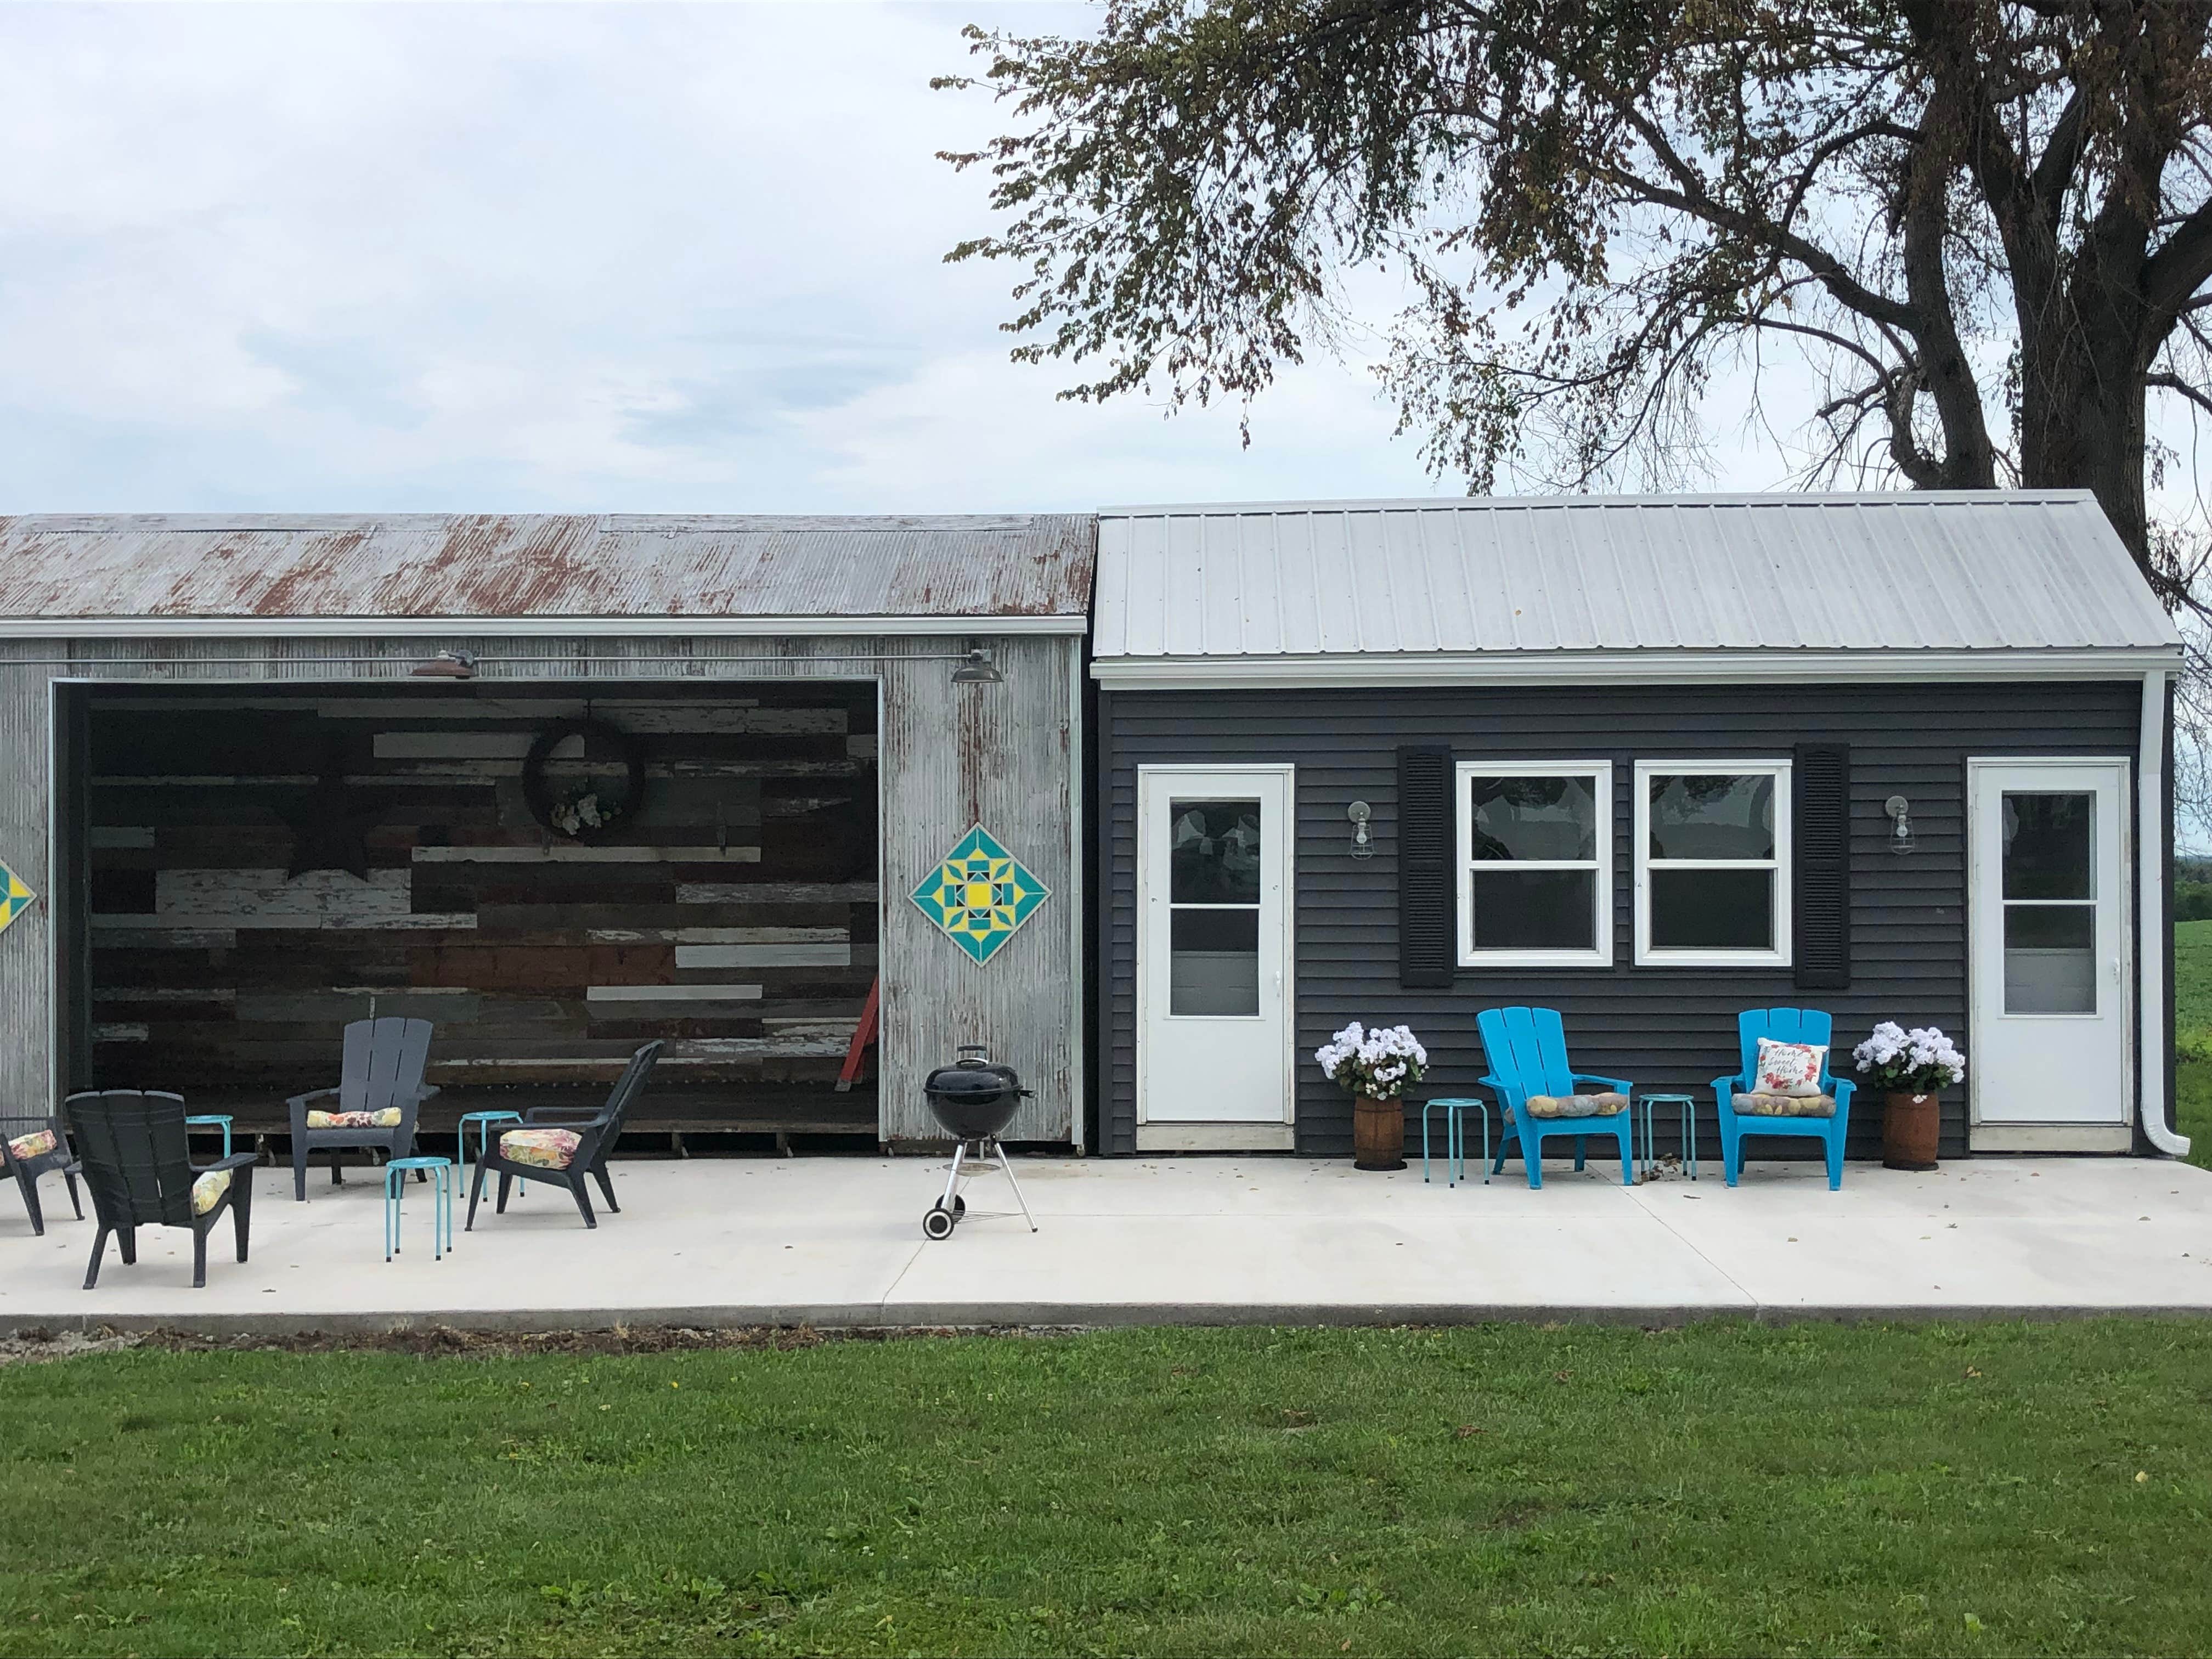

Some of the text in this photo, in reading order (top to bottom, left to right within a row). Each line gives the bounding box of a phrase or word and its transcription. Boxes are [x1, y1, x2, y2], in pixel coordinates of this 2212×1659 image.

[1774, 1048, 1803, 1057] Home
[1768, 1057, 1796, 1066] Sweet
[1776, 1065, 1803, 1075] Home
